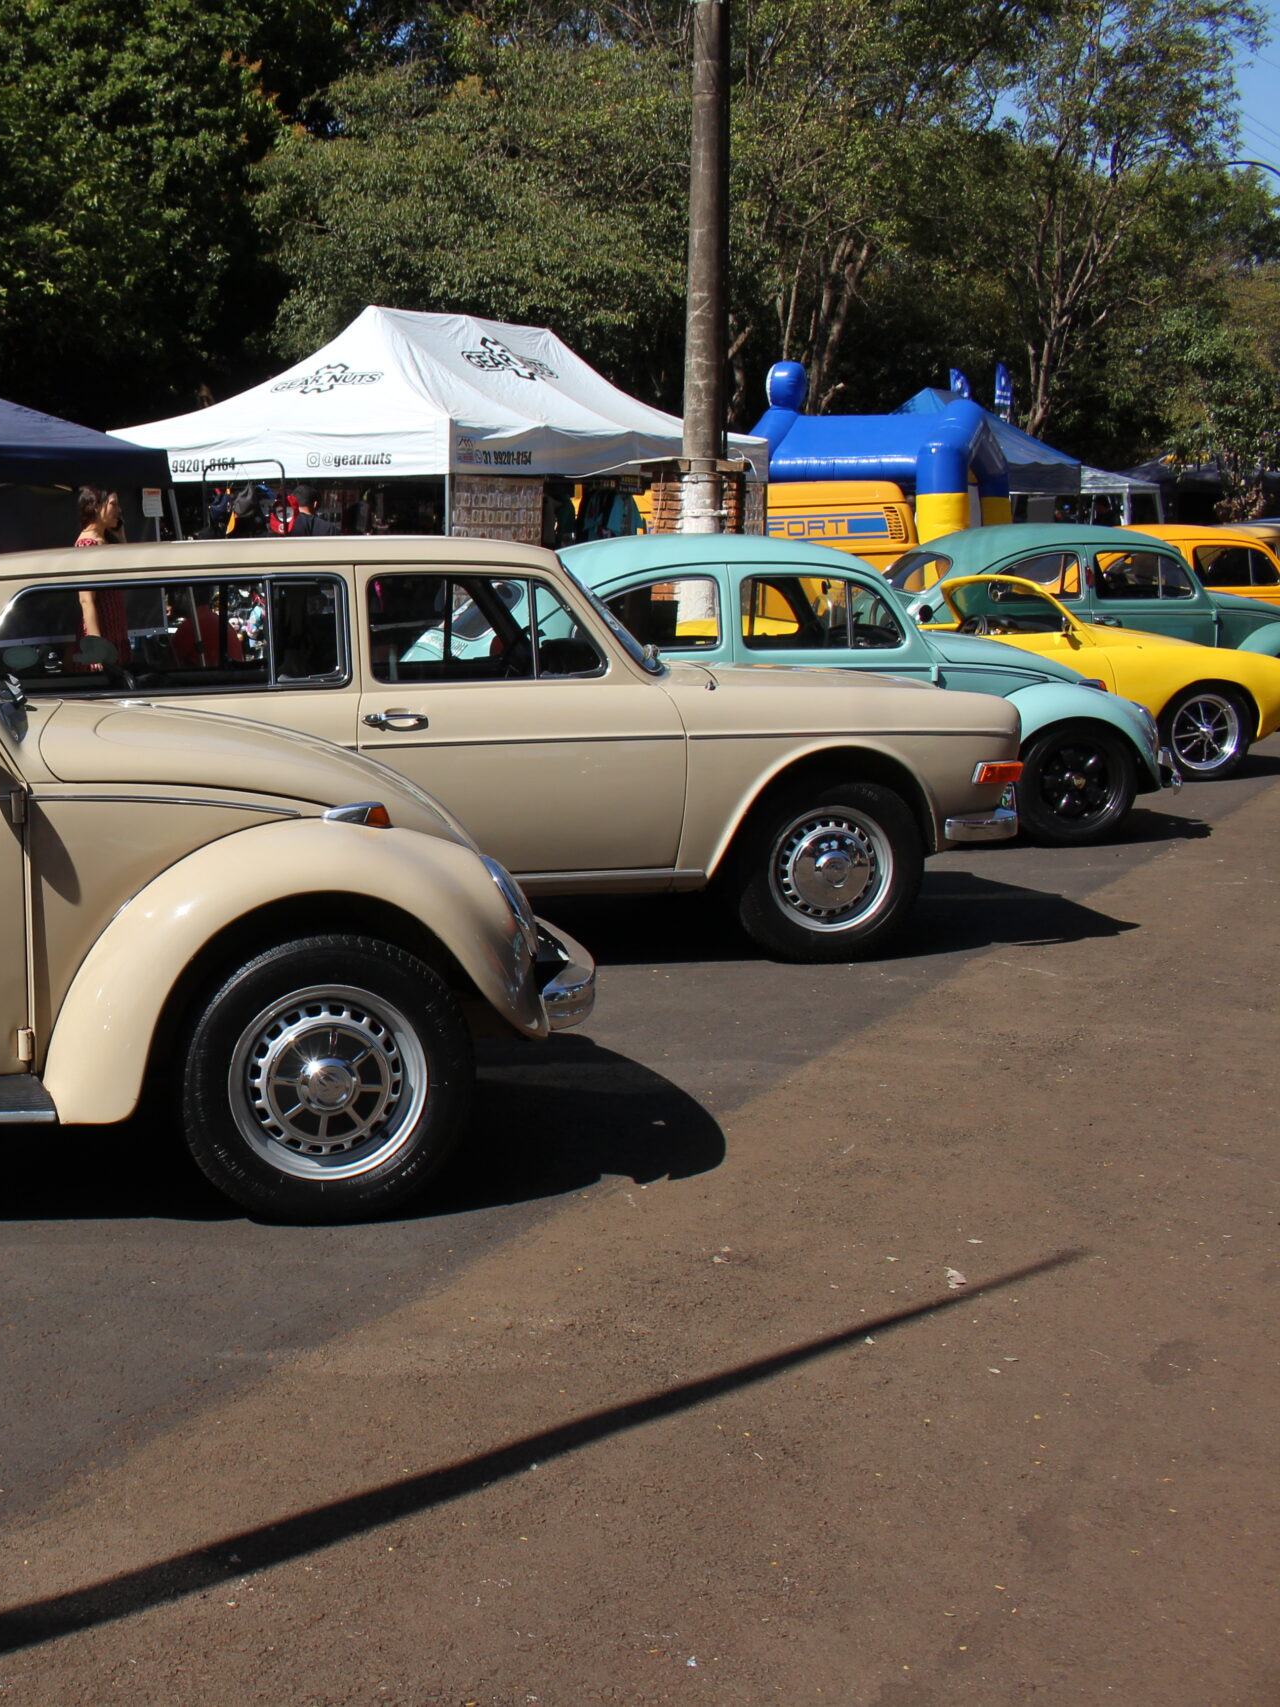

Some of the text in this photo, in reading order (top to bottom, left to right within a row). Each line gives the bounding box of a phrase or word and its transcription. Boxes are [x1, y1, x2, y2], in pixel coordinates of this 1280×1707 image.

[273, 373, 379, 391] GEAR NUTS
[322, 452, 393, 468] @gear.nuts
[482, 450, 492, 465] 31
